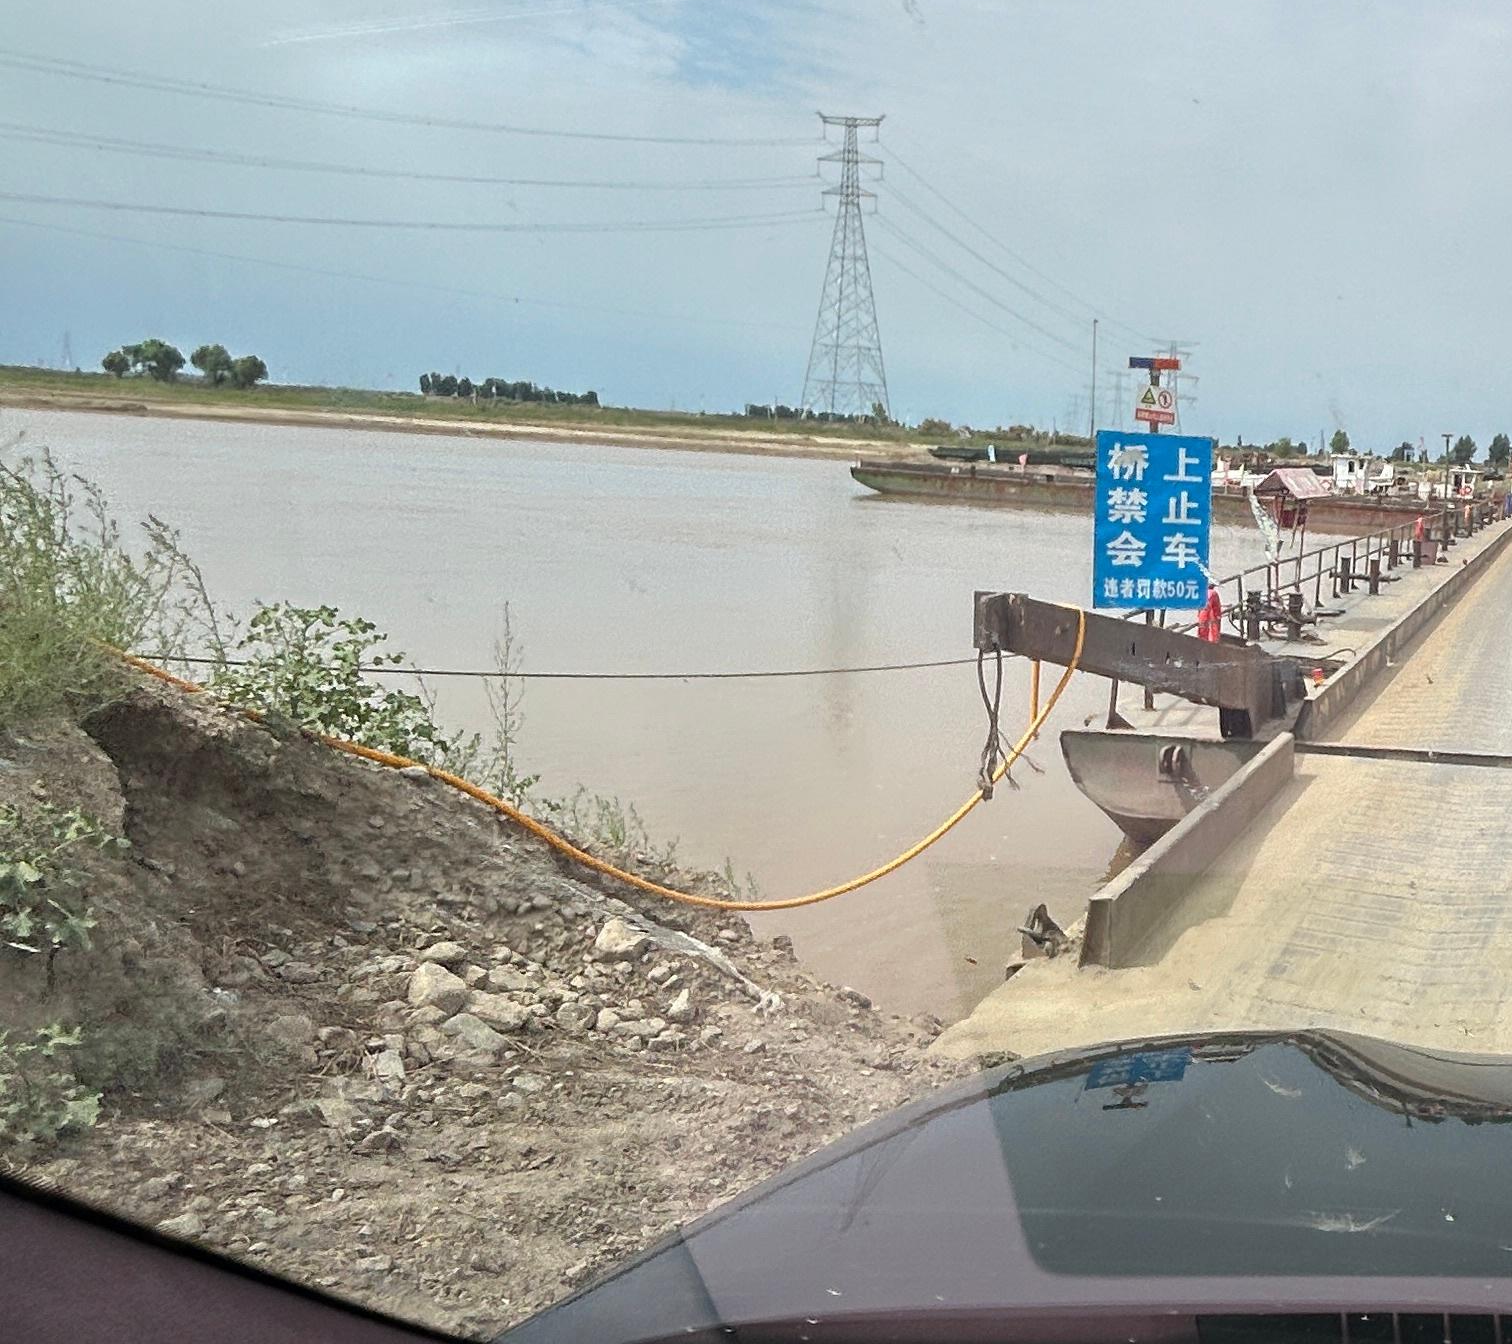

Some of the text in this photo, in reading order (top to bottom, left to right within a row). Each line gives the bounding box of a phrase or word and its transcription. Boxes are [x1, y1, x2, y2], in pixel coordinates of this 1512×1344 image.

[1107, 486, 1202, 525] 禁止
[1106, 529, 1201, 569] 会车
[1103, 576, 1200, 600] 违者罚款50元
